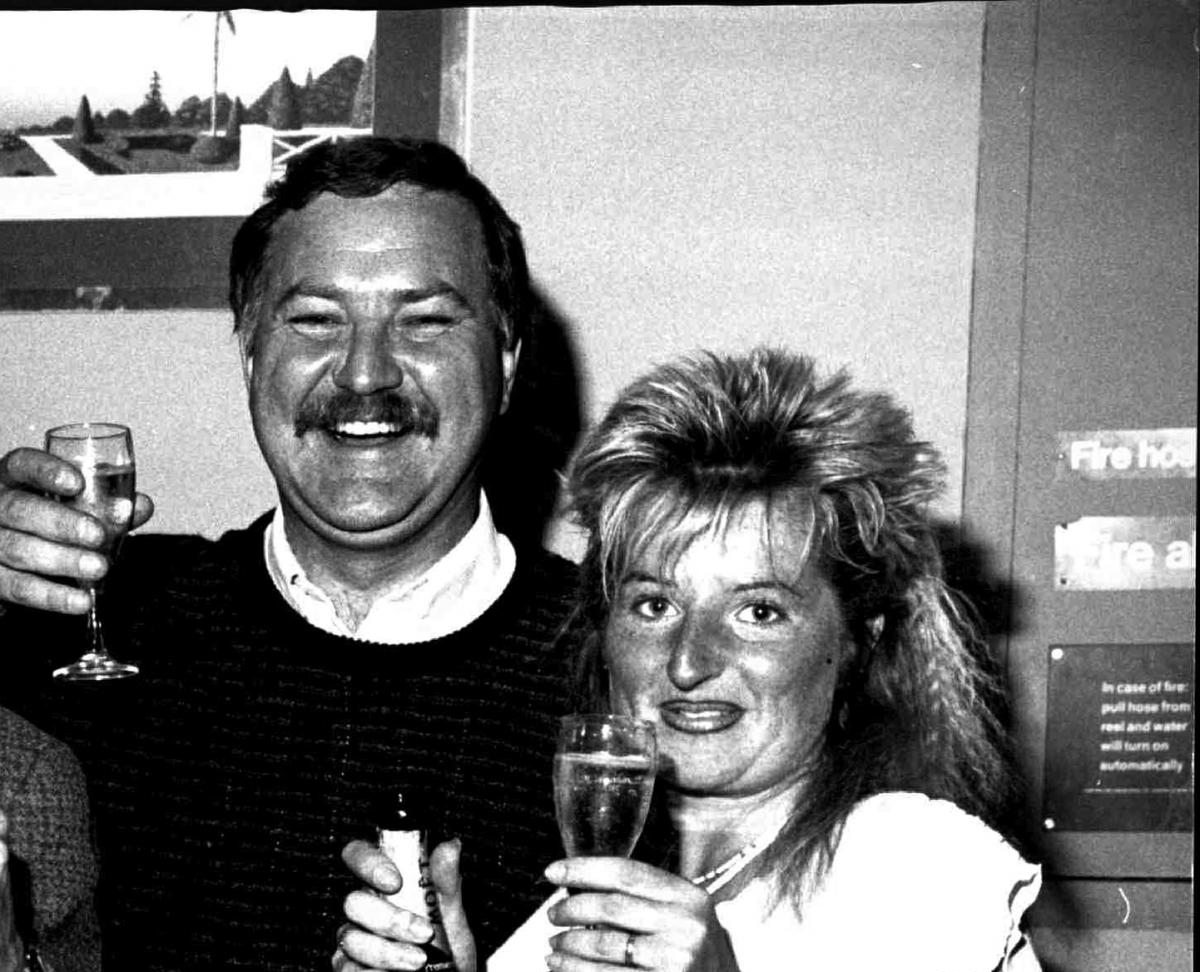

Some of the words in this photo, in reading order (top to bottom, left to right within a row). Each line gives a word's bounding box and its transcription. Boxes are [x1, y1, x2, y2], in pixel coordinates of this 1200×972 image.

[1070, 440, 1133, 470] Fire
[1165, 531, 1196, 570] a
[1101, 681, 1114, 694] In
[1116, 683, 1146, 694] case
[1148, 680, 1161, 694] of
[1101, 701, 1126, 715] pull
[1127, 701, 1159, 713] hose
[1161, 700, 1191, 713] from
[1101, 721, 1125, 732] reel
[1126, 721, 1151, 732] and
[1153, 722, 1188, 732] water
[1100, 740, 1122, 751] will
[1124, 741, 1150, 751] turn
[1152, 742, 1170, 751] on
